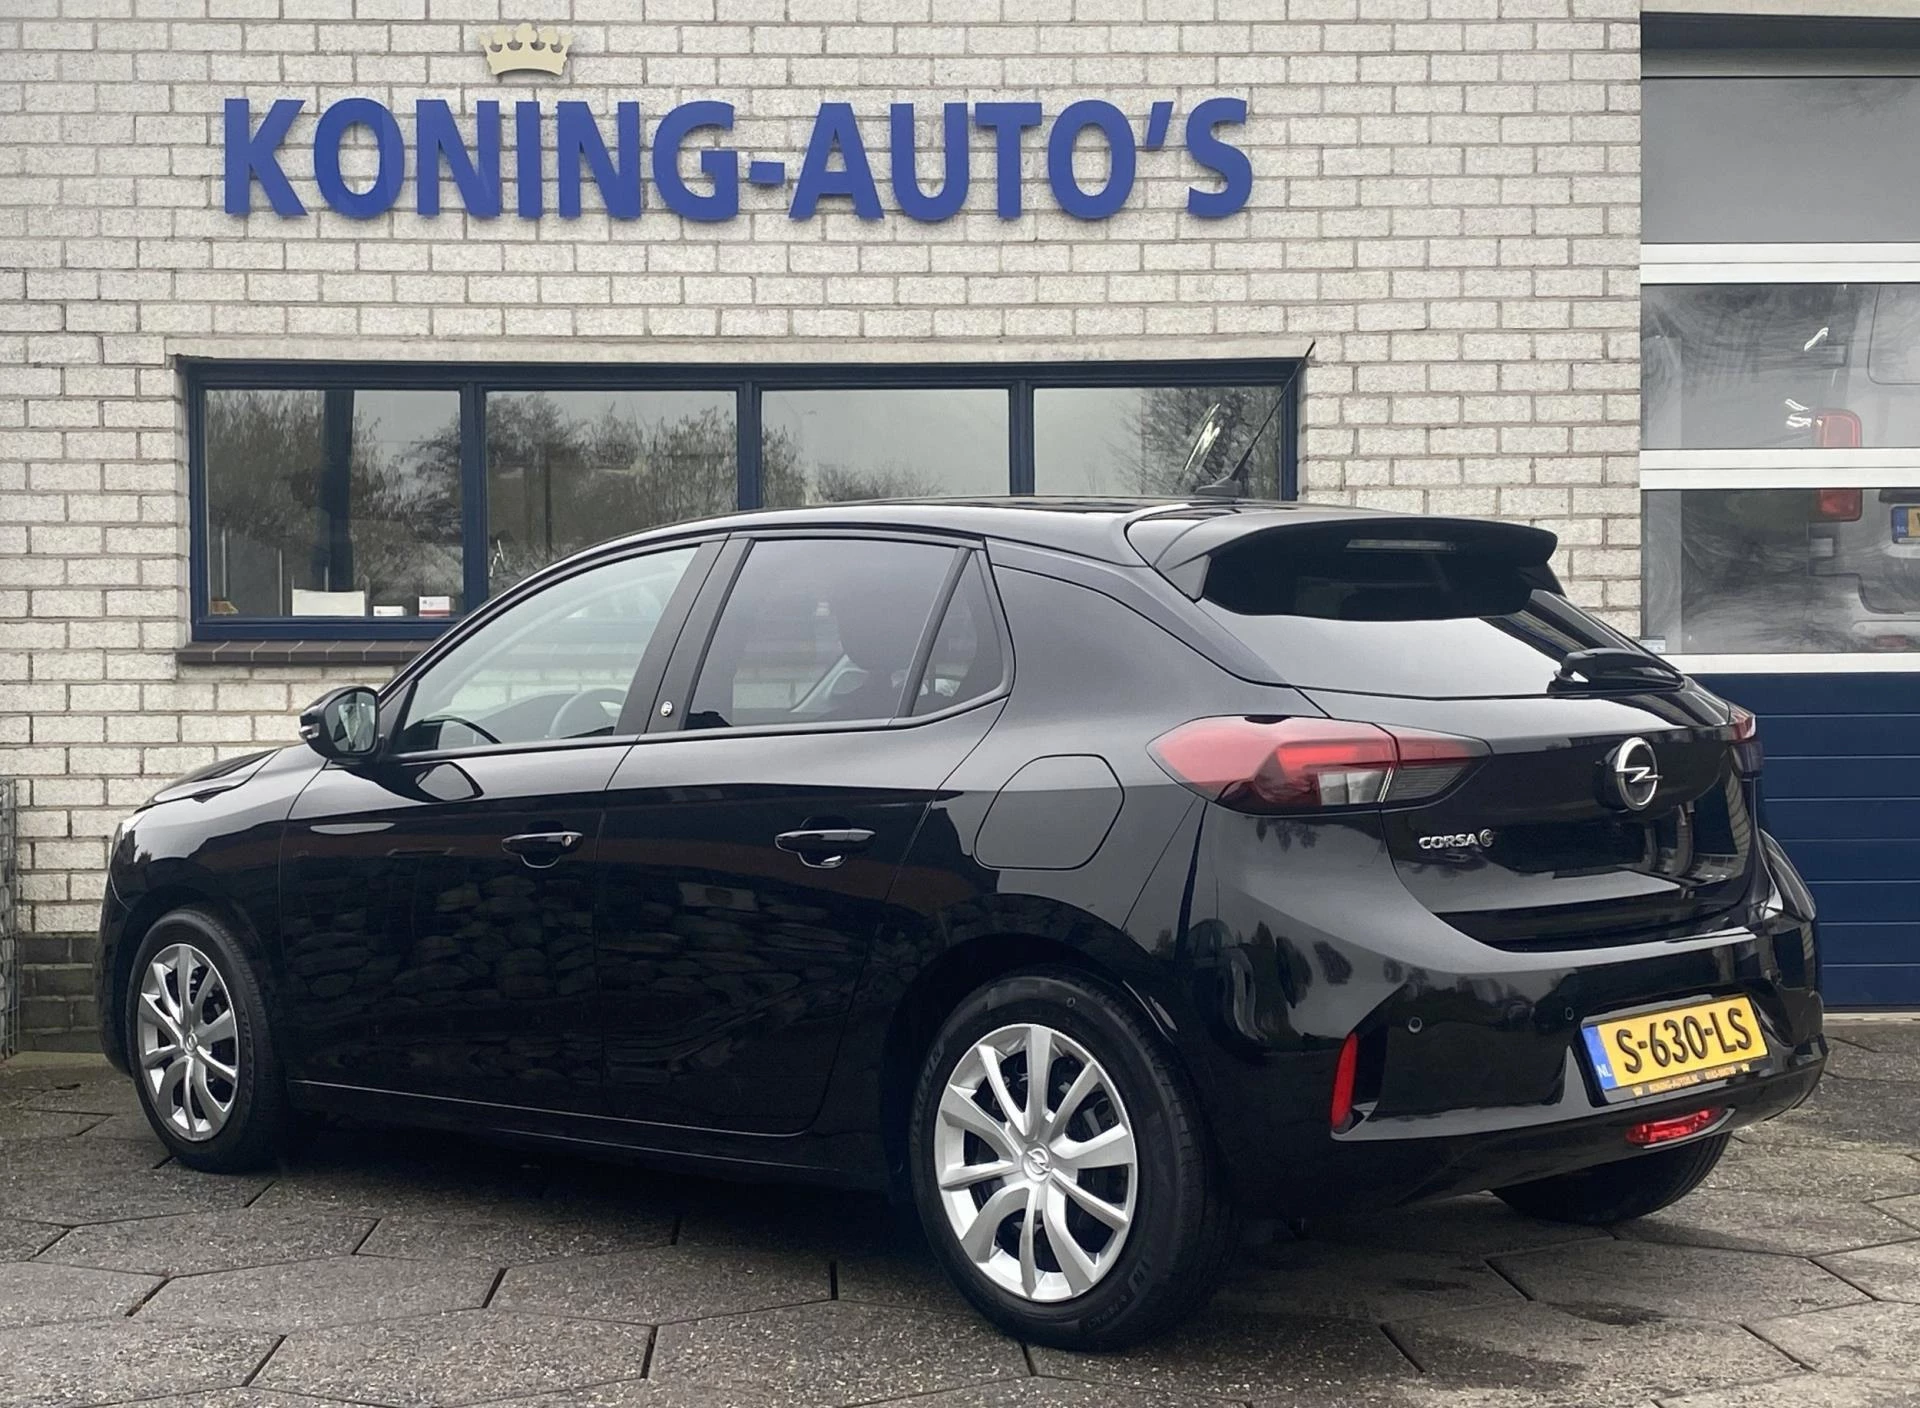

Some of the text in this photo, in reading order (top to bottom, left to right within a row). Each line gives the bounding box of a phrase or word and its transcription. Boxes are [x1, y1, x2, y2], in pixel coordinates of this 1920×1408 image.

[224, 97, 1253, 222] KONING-AUTO'S
[1418, 832, 1479, 849] CORSA
[1616, 1007, 1752, 1074] S-630-LS
[1595, 1064, 1612, 1077] NL
